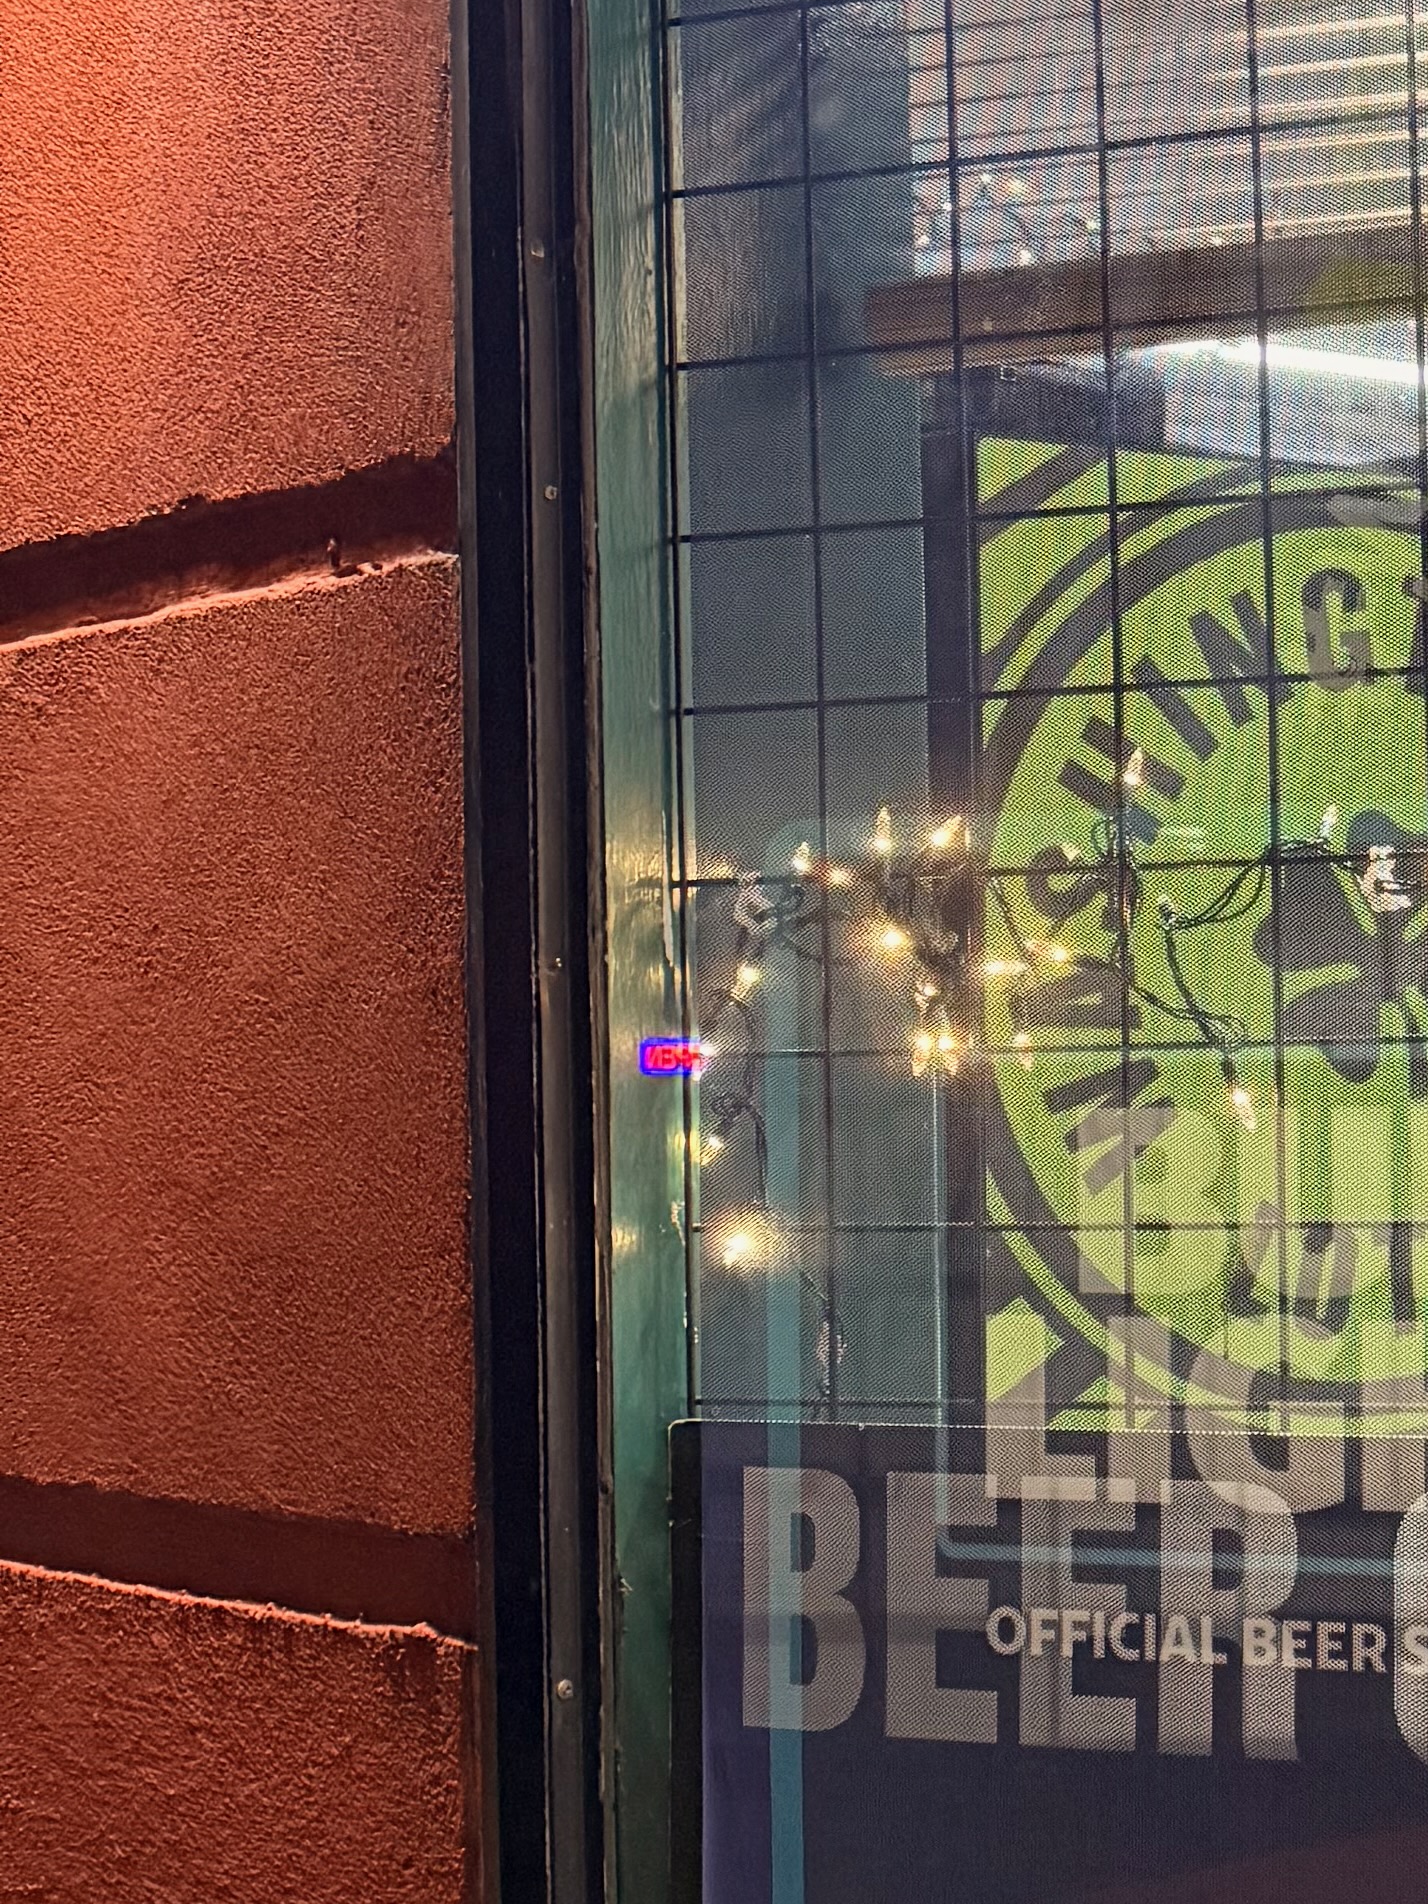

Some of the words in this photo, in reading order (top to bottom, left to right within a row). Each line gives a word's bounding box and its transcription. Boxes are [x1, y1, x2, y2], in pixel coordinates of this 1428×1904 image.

[742, 1466, 1302, 1762] BEER
[985, 1605, 1228, 1666] OFFICIAL
[1242, 1616, 1389, 1675] BEER
